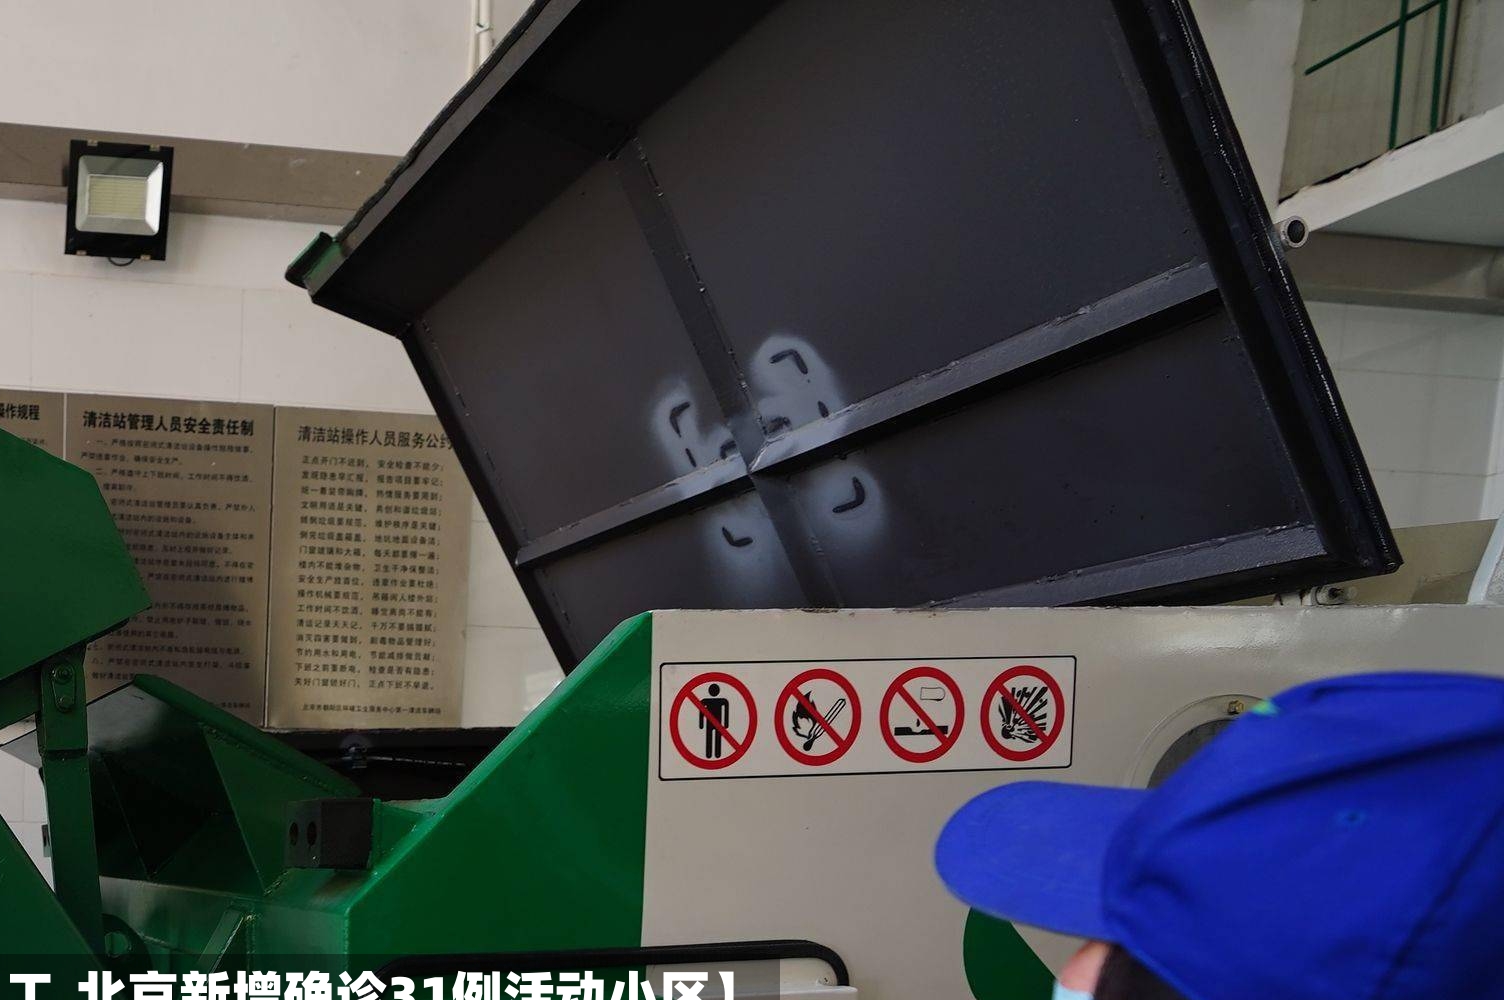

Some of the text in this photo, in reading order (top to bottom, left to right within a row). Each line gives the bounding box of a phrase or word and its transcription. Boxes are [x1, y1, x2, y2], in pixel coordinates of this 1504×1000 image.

[83, 410, 254, 436] 清洁站管理人员安全责任制
[298, 425, 453, 449] 清洁站操作人员服务公约
